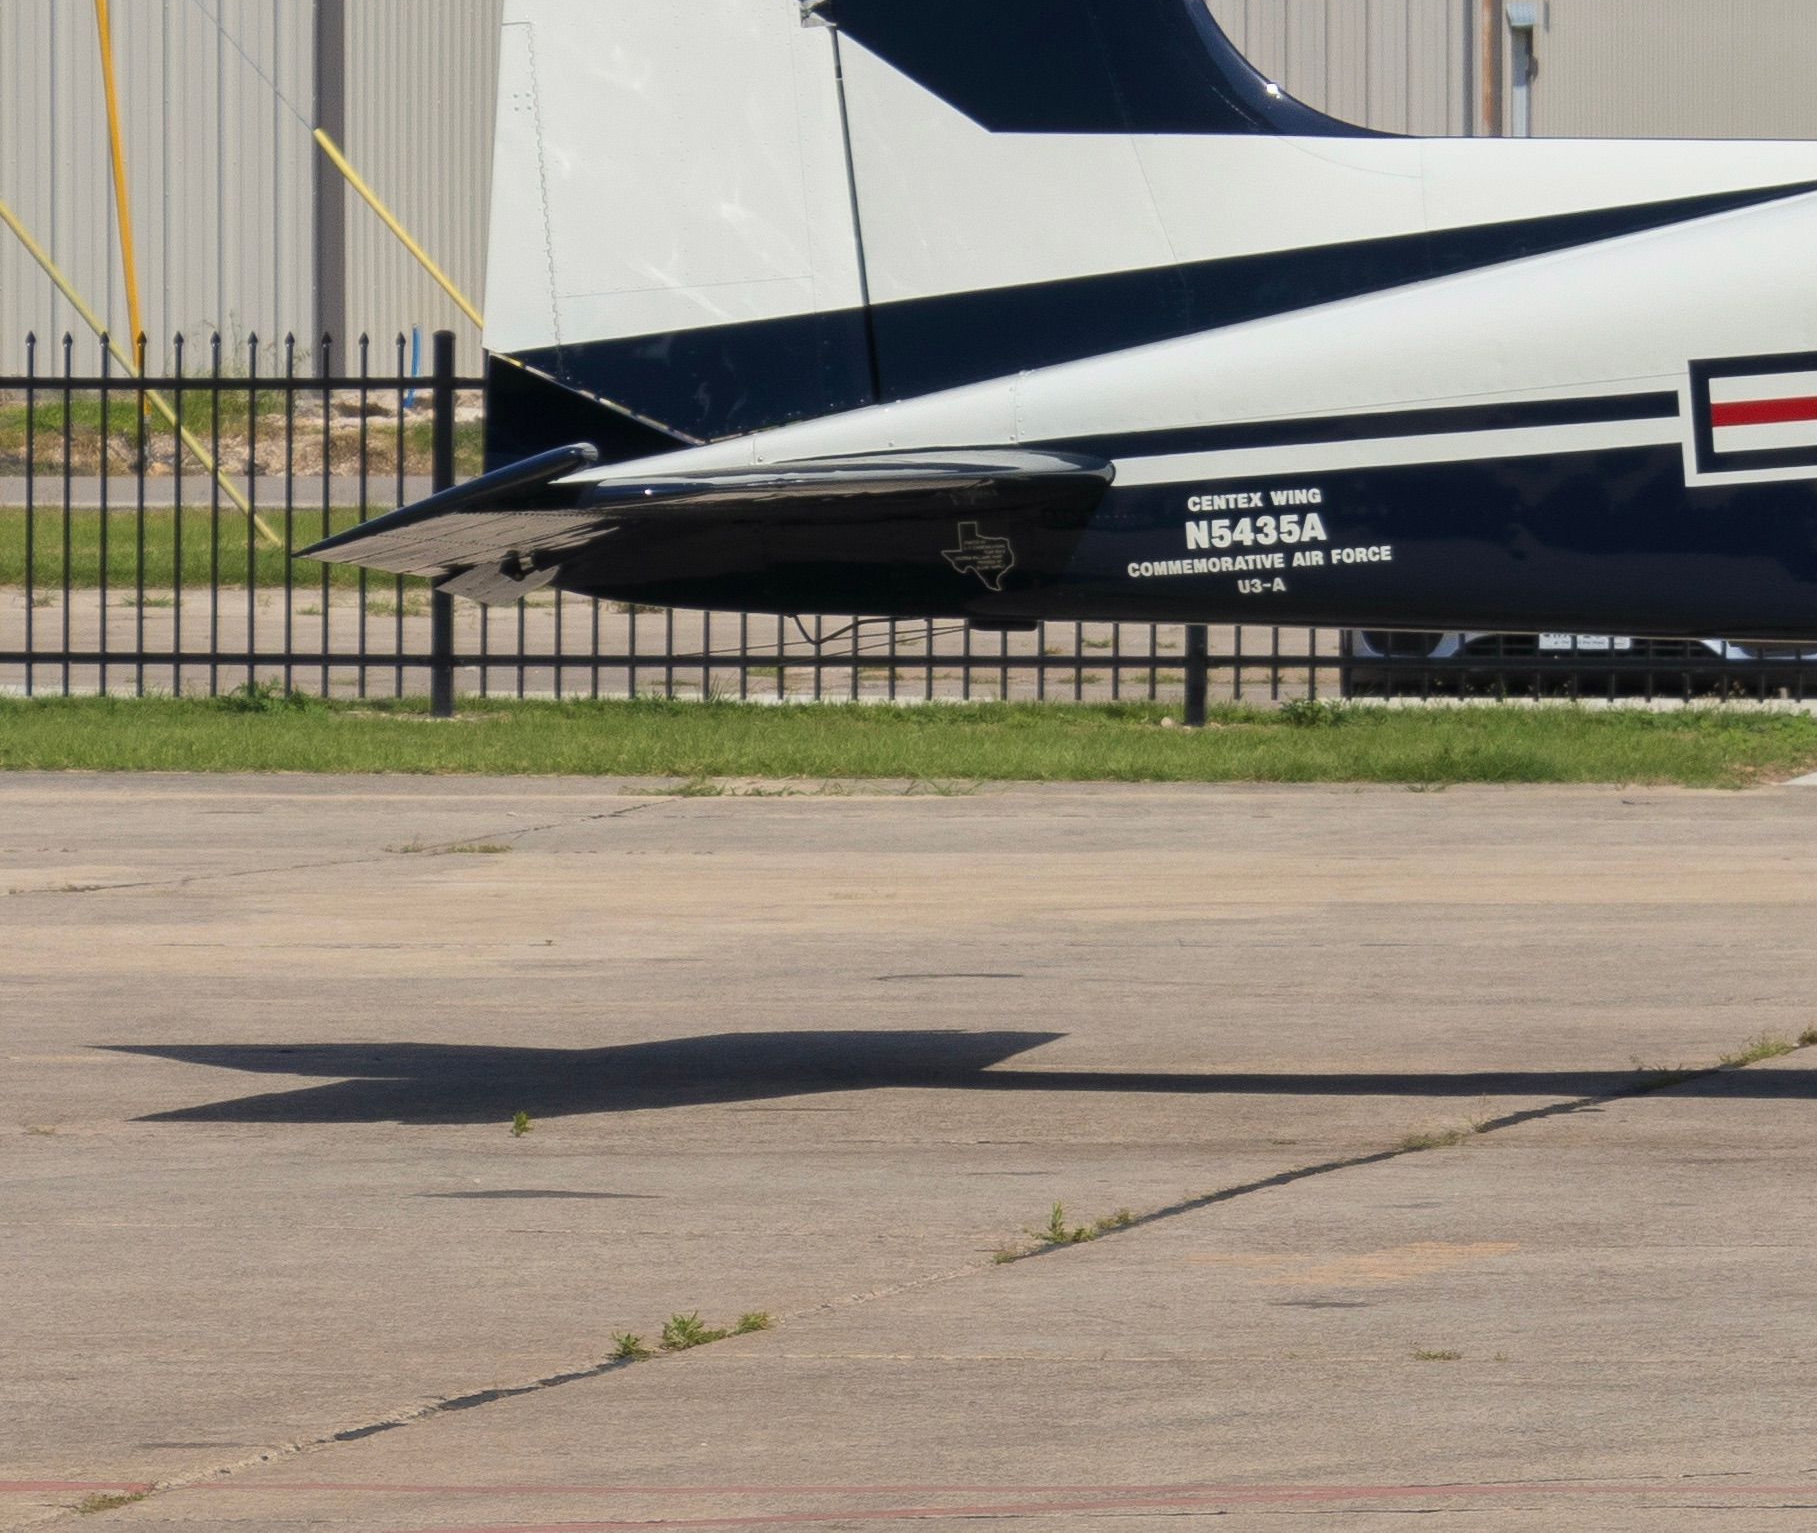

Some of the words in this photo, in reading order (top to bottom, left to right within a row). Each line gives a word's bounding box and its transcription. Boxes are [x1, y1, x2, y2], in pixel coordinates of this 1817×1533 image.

[1187, 491, 1264, 512] CENTEX
[1270, 488, 1322, 505] WING
[1185, 512, 1327, 550] N5435A
[1127, 552, 1286, 579] COMMEMORATIVE
[1291, 550, 1325, 567] AIR
[1330, 545, 1393, 565] FORCE
[1237, 577, 1287, 594] U3-A
